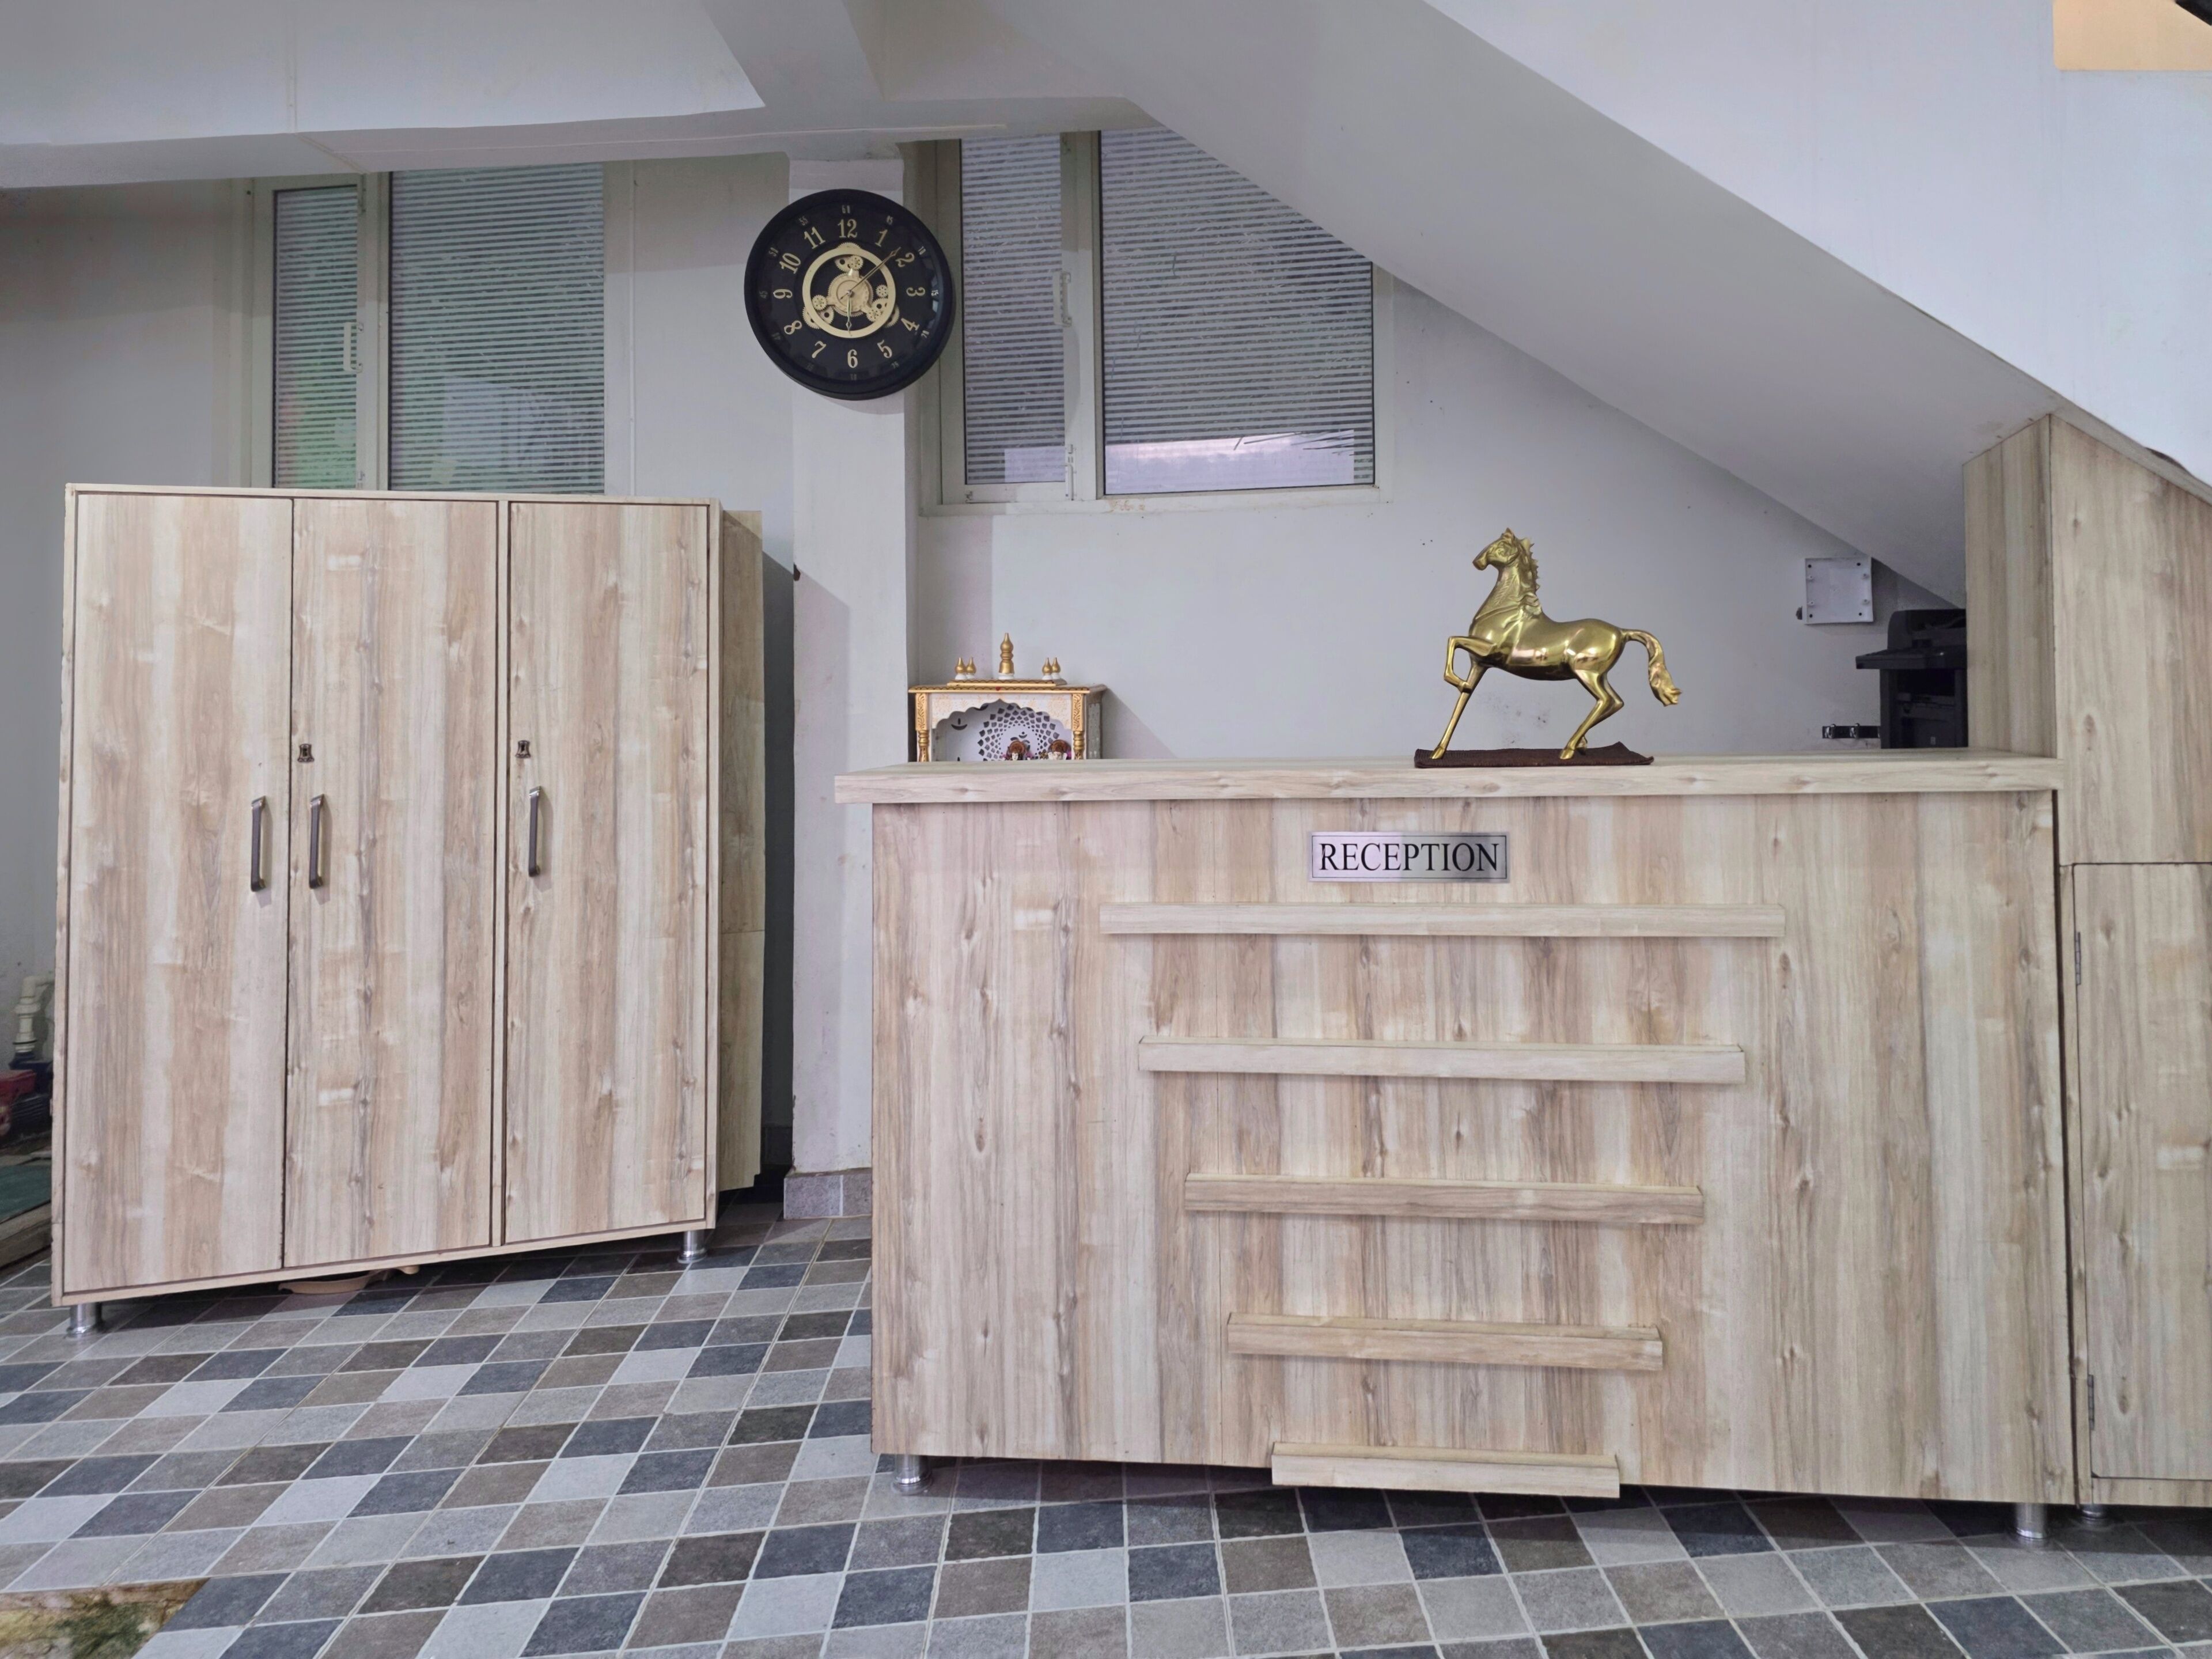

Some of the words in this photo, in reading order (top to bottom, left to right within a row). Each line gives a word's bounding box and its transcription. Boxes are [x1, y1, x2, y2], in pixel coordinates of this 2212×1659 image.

[838, 219, 857, 238] 12
[804, 227, 825, 249] 11
[875, 229, 888, 247] 1
[779, 253, 801, 274] 10
[896, 253, 914, 267] 2
[773, 289, 793, 298] 9
[906, 287, 925, 297] 3
[784, 320, 802, 335] 8
[901, 318, 919, 331] 4
[812, 341, 826, 358] 7
[877, 340, 892, 358] 5
[848, 350, 858, 368] 6
[1319, 843, 1499, 872] RECEPTION
